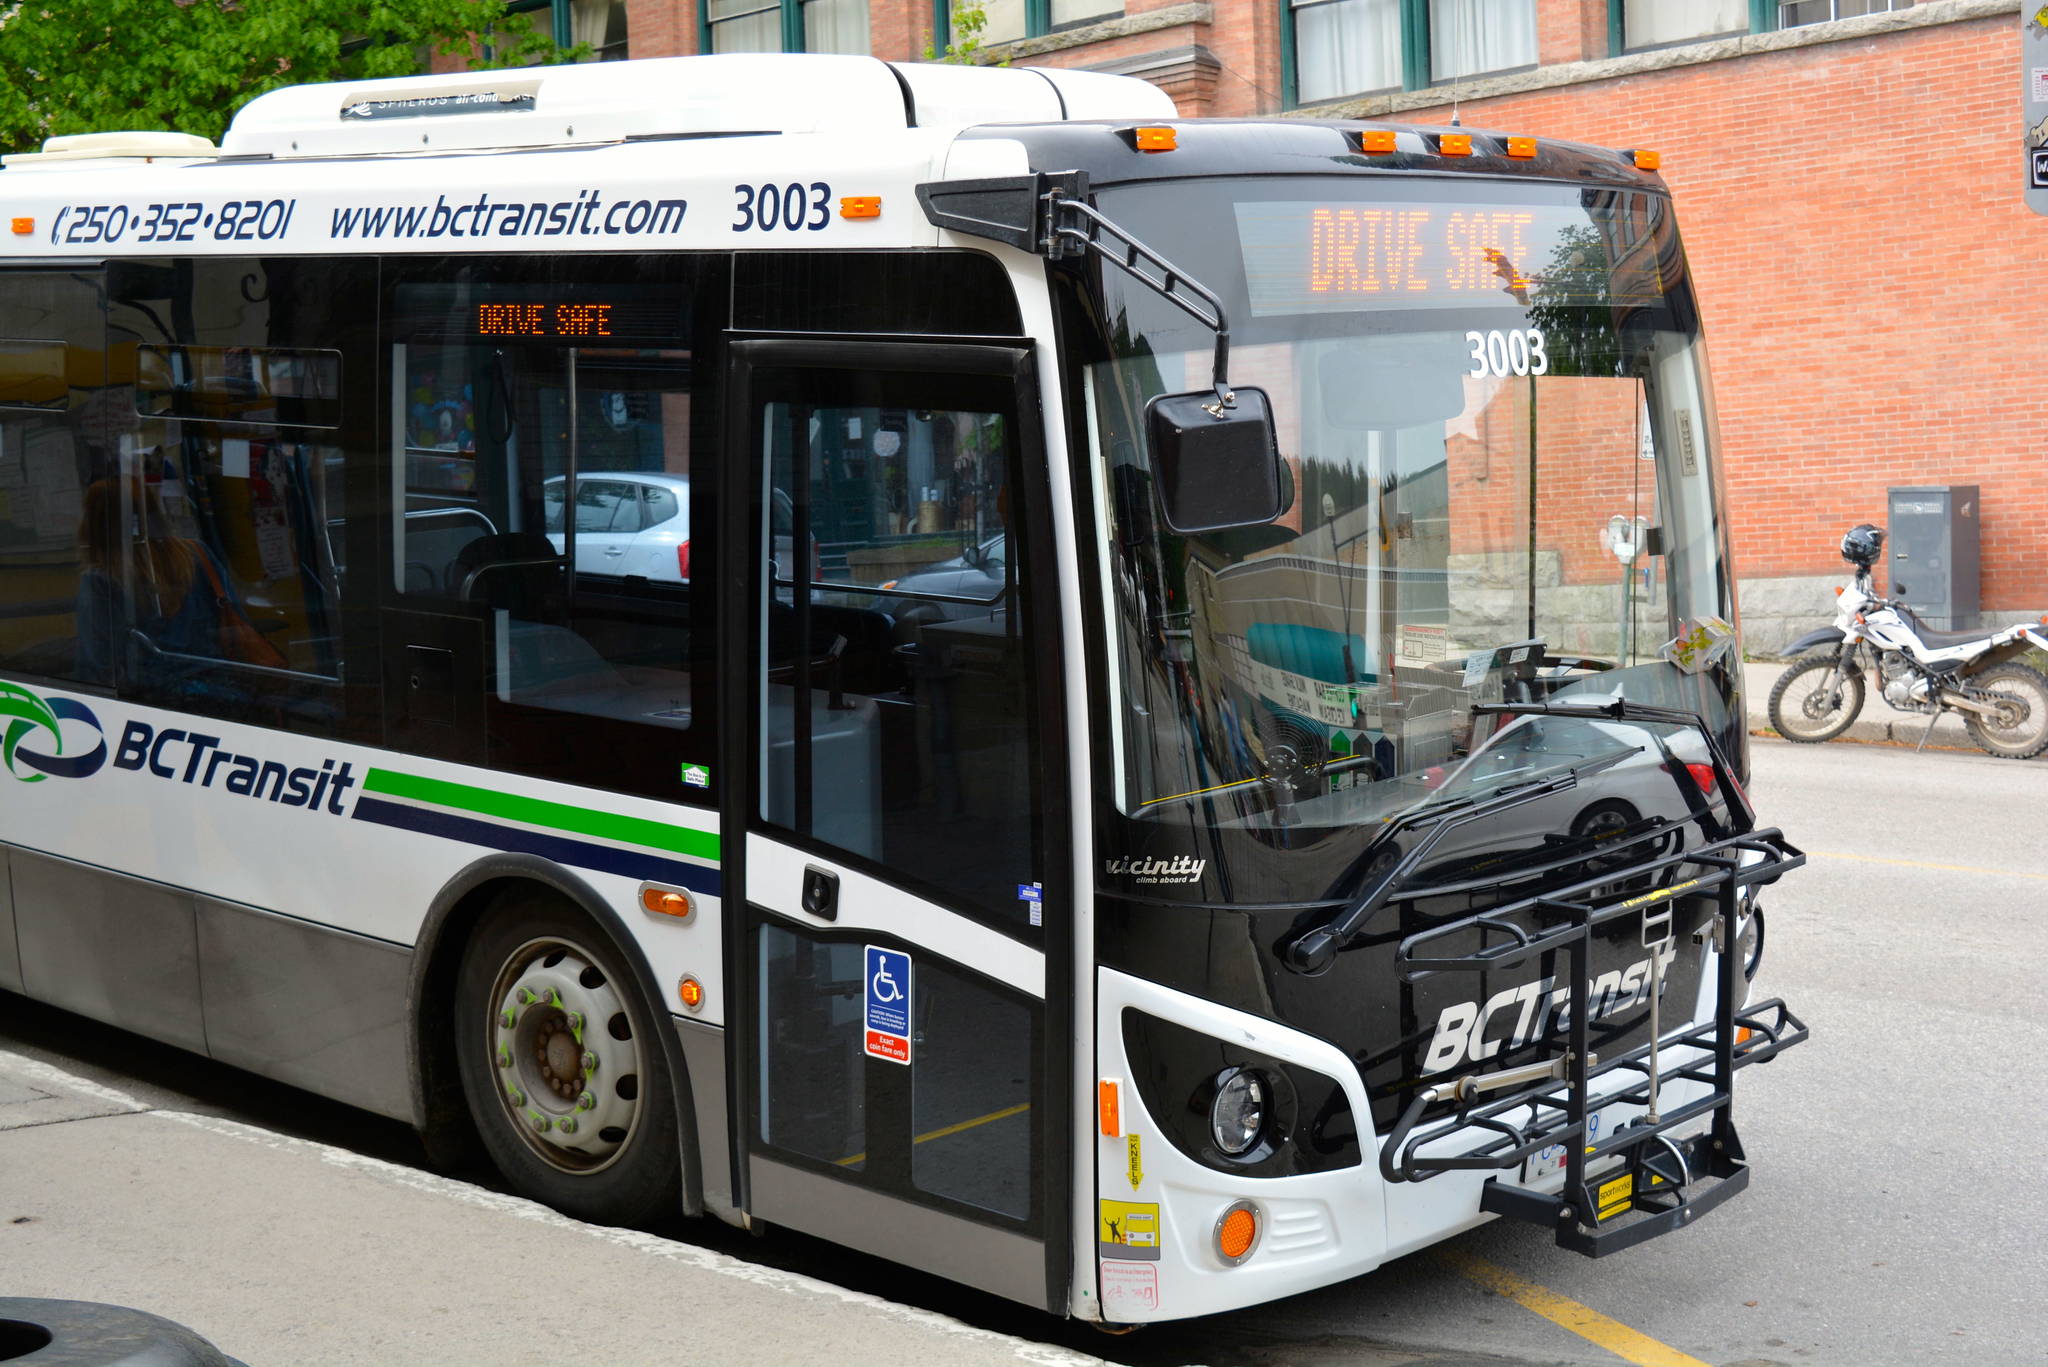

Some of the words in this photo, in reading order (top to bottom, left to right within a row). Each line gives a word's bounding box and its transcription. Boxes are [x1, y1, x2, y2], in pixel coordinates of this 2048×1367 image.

[330, 189, 688, 238] www.bctransit.com
[731, 181, 832, 232] 3003
[1311, 208, 1430, 292] DRIVE
[1445, 211, 1534, 290] SAFE
[478, 303, 545, 335] DRIVE
[556, 303, 612, 335] SAFE
[1465, 328, 1548, 379] 3003
[113, 720, 355, 816] BCTransit
[1105, 855, 1207, 883] vicinity
[1136, 876, 1158, 884] climb
[1159, 876, 1187, 884] aboard
[869, 1043, 881, 1051] coin
[881, 1045, 893, 1054] fare
[893, 1049, 906, 1059] only
[879, 1035, 894, 1046] Exact
[1130, 1143, 1139, 1186] KNEELS
